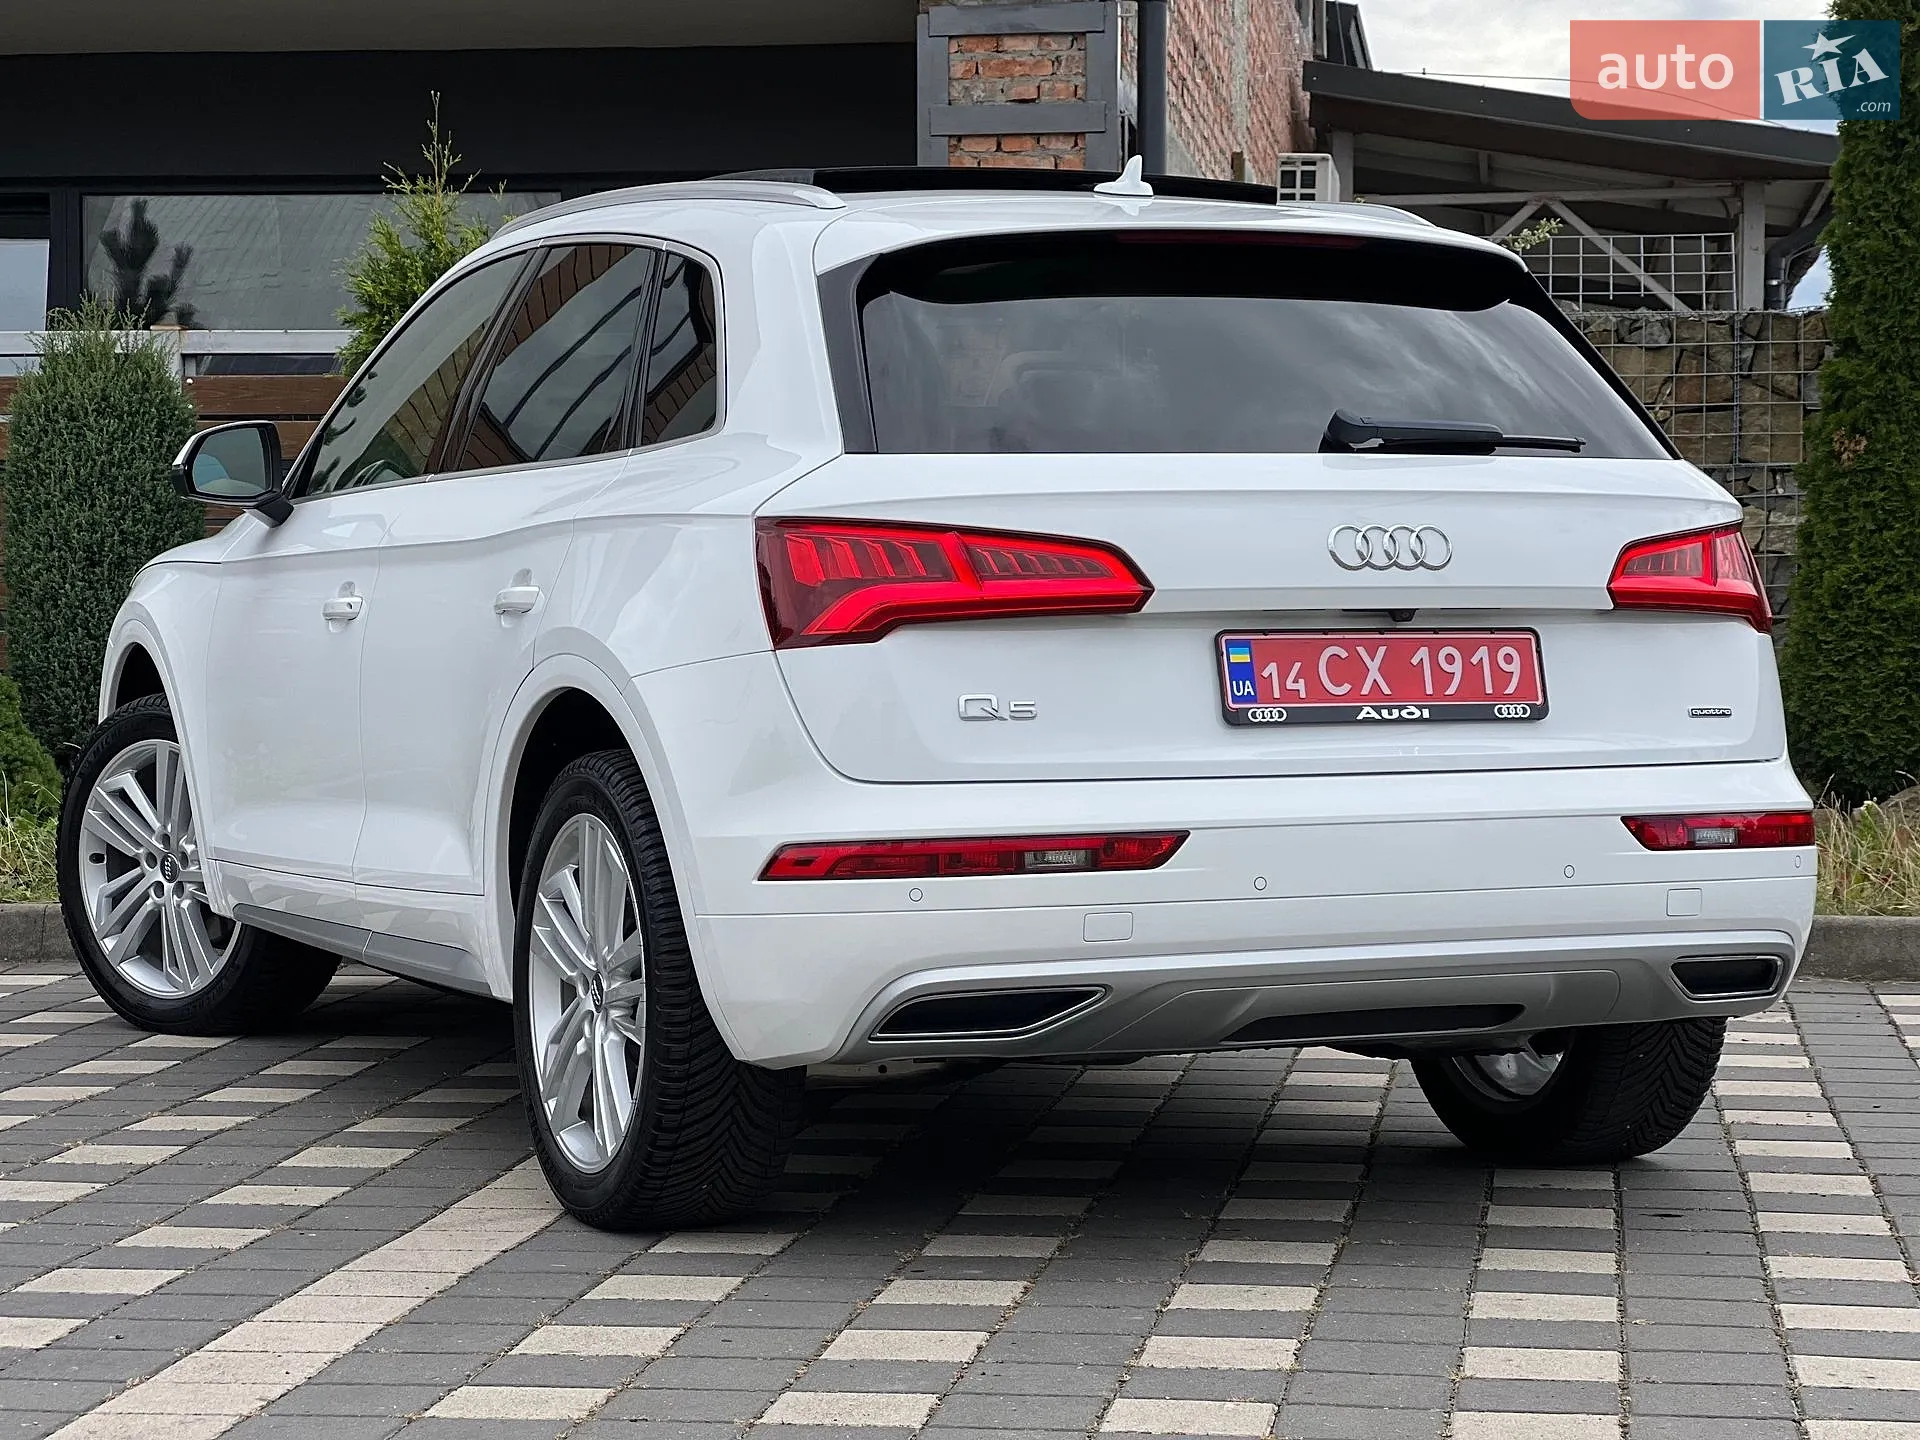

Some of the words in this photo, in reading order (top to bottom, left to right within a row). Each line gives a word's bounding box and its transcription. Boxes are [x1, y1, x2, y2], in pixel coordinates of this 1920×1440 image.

[1261, 662, 1306, 699] 14
[1317, 645, 1392, 696] CX
[1410, 645, 1521, 695] 1919
[1232, 680, 1254, 697] UA
[958, 693, 1037, 721] Q5
[1356, 706, 1430, 720] Audi
